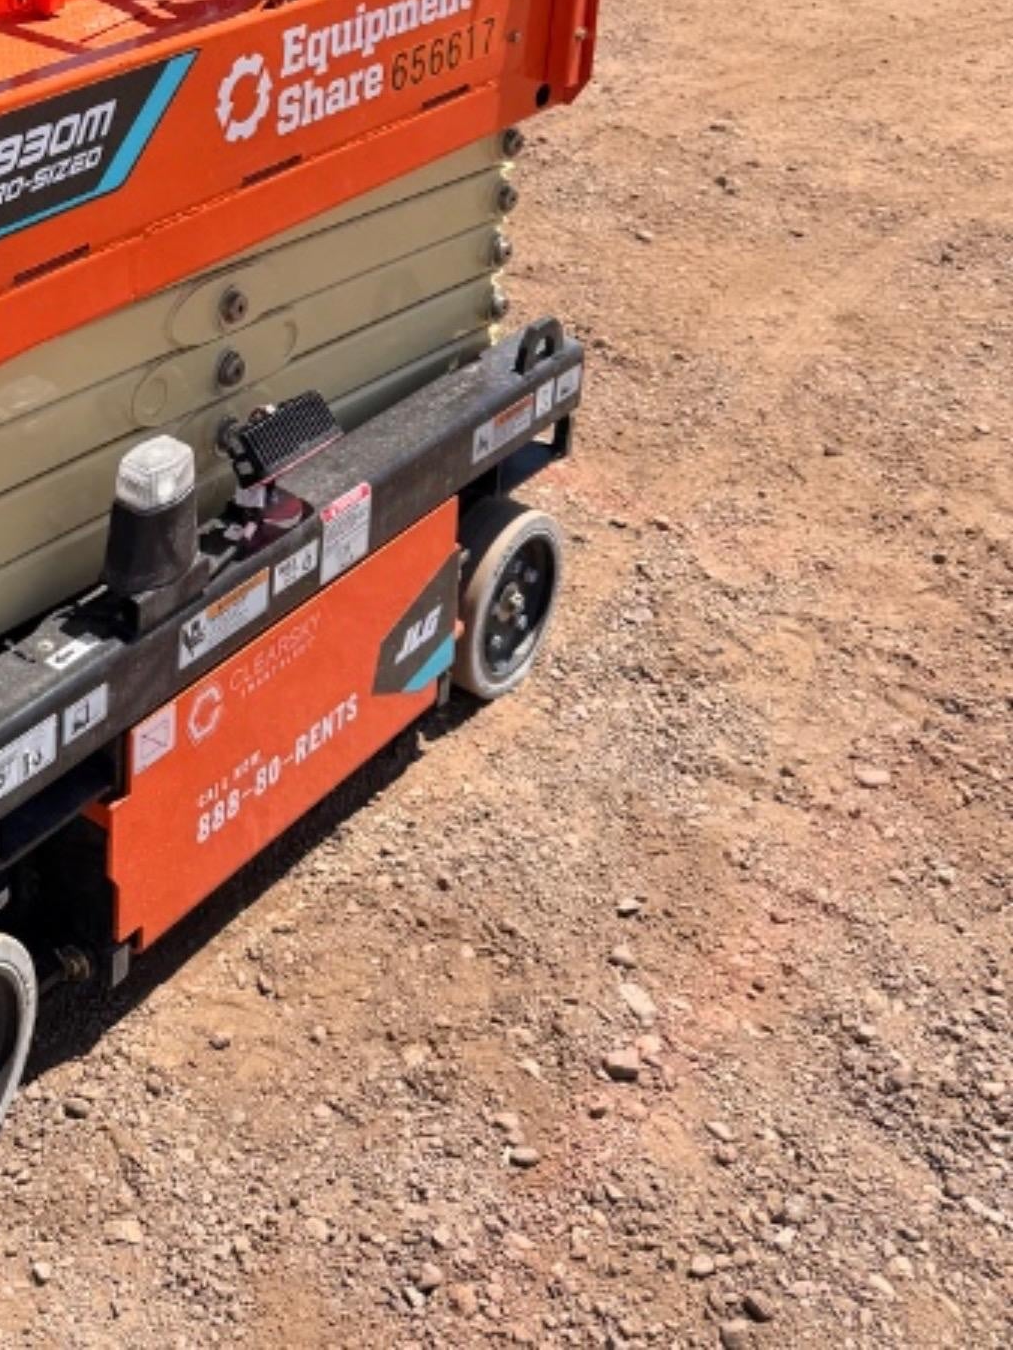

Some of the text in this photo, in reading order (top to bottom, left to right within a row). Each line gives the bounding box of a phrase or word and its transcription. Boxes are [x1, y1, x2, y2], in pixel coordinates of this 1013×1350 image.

[391, 17, 496, 91] 656617
[276, 61, 385, 136] Share
[196, 692, 359, 845] 888-80-RENTS
